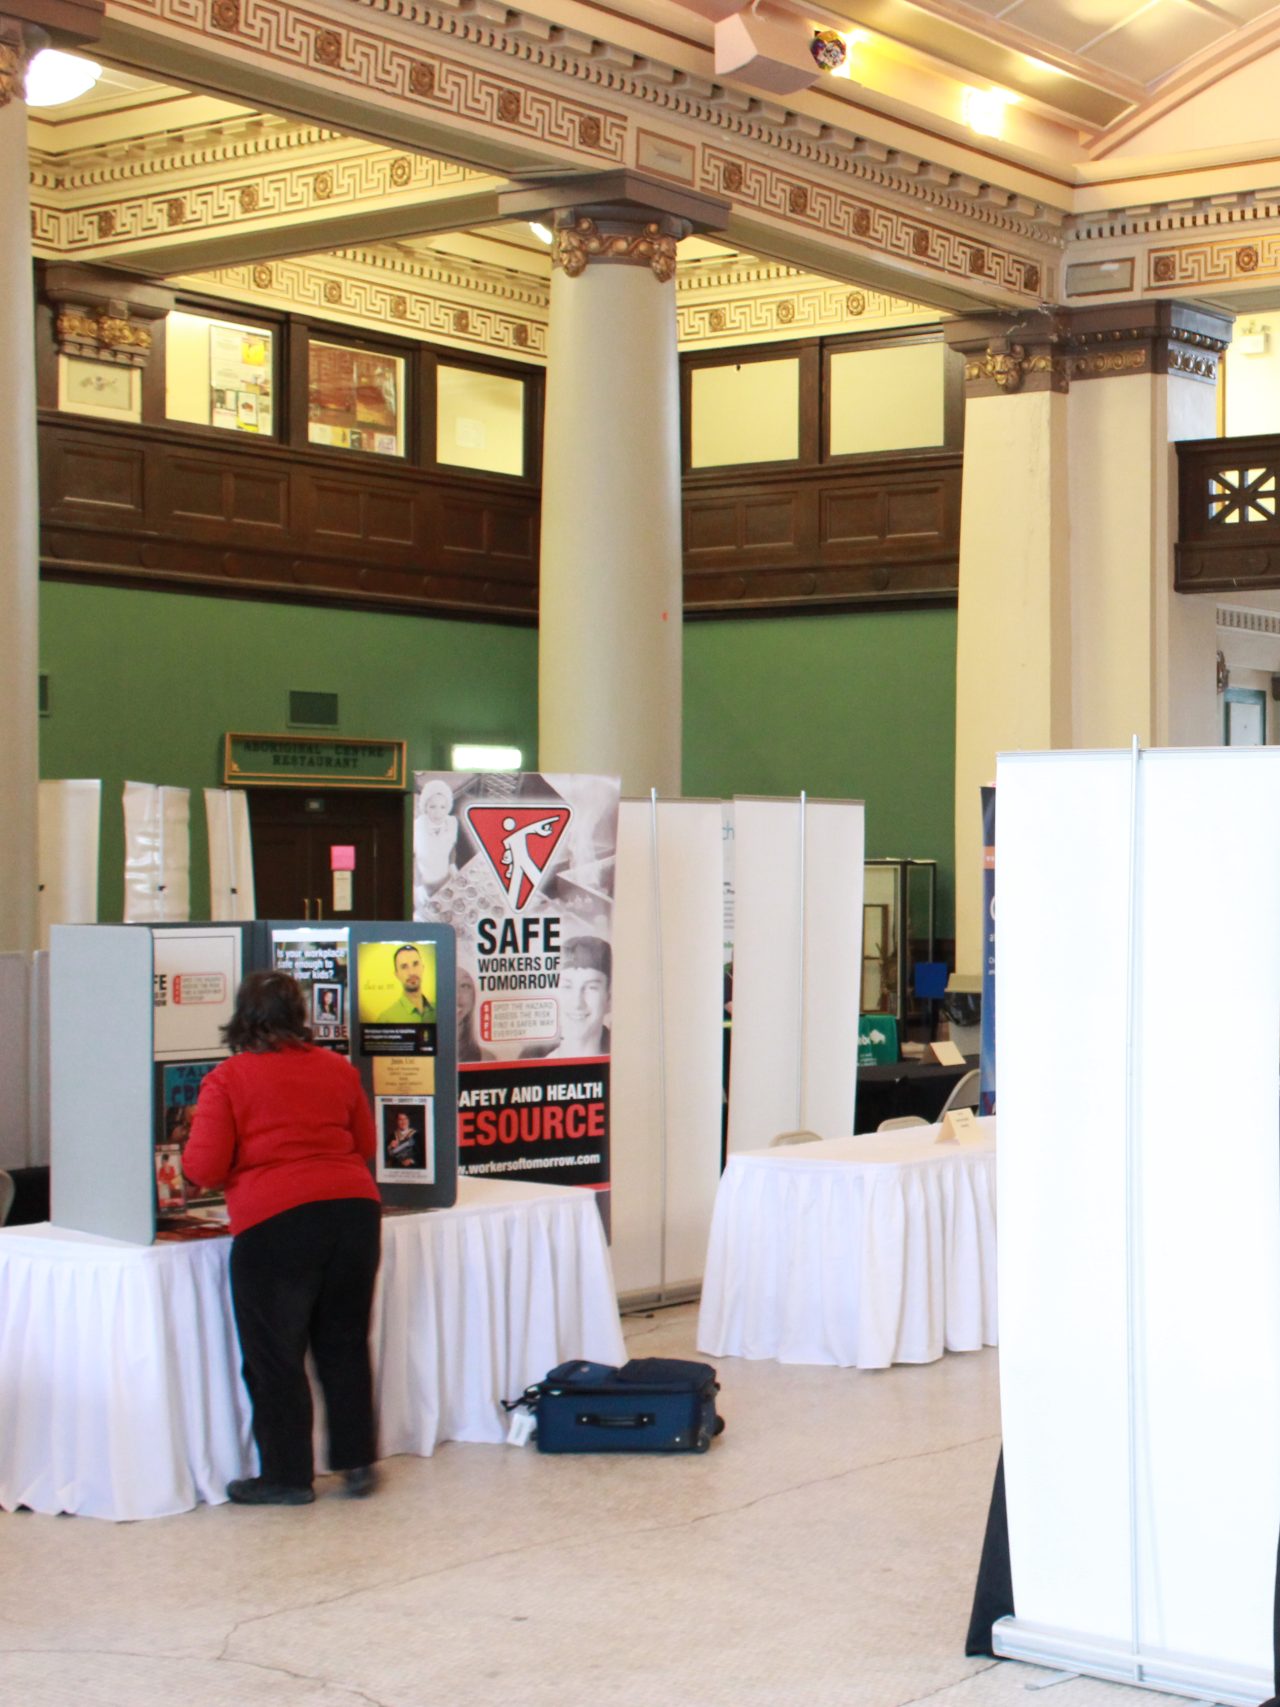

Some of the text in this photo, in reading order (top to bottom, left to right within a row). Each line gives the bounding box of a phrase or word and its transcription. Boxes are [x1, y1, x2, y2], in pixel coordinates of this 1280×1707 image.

[243, 741, 386, 758] ABORIGINAL CENTRE
[272, 755, 359, 769] RESTAURANT
[477, 917, 561, 956] SAFE
[304, 948, 345, 960] workplace
[294, 959, 324, 971] enough
[325, 960, 334, 968] to
[478, 956, 560, 973] WORKERS OF
[312, 969, 335, 980] kids?
[478, 973, 560, 991] TOMORROW
[525, 1001, 554, 1010] HAZARD
[458, 1081, 603, 1108] AFETY AND HEALTH
[458, 1102, 605, 1148] ESOURCE
[457, 1153, 600, 1176] w.workersoftomorrow.com
